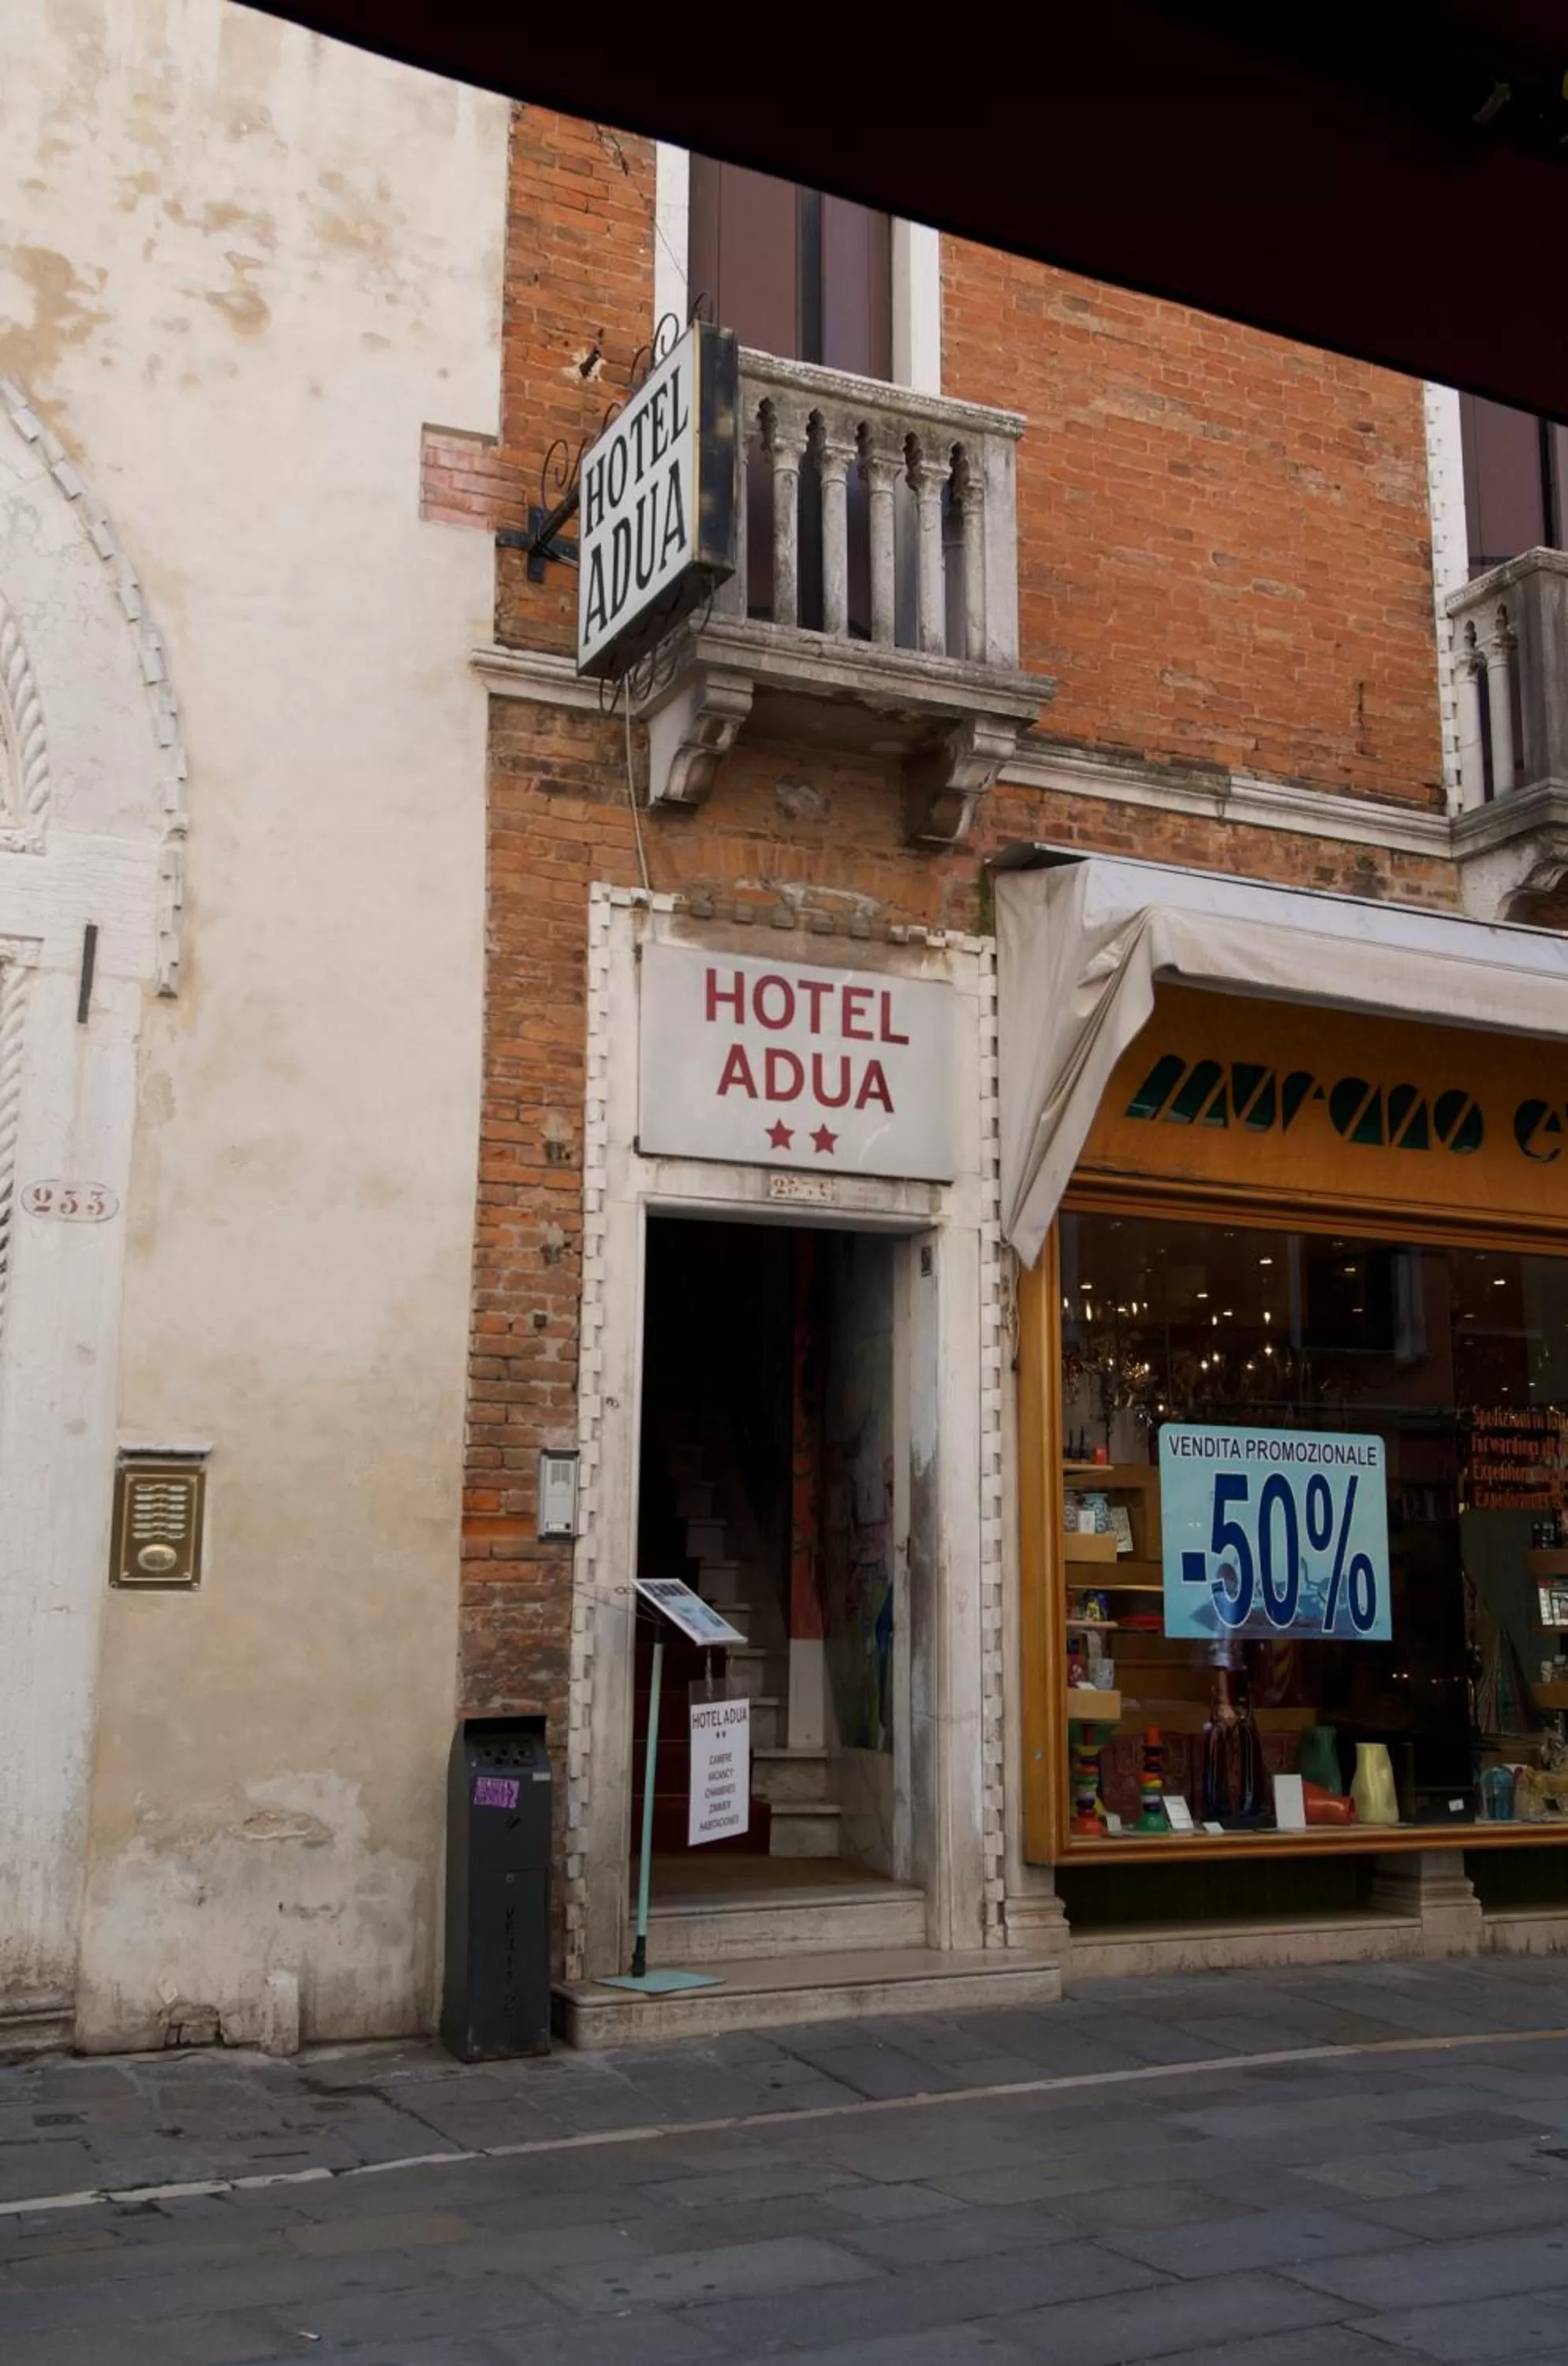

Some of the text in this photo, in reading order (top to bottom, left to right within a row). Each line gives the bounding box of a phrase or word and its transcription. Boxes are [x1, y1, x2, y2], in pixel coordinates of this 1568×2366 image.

[584, 365, 689, 539] HOTEL
[582, 459, 687, 647] ADUA
[706, 968, 909, 1045] HOTEL
[716, 1043, 894, 1114] ADUA
[1169, 1435, 1377, 1467] VENDITA PROMOZIONALE
[1181, 1472, 1376, 1633] -50%
[692, 1706, 748, 1730] HOTEL ADUA
